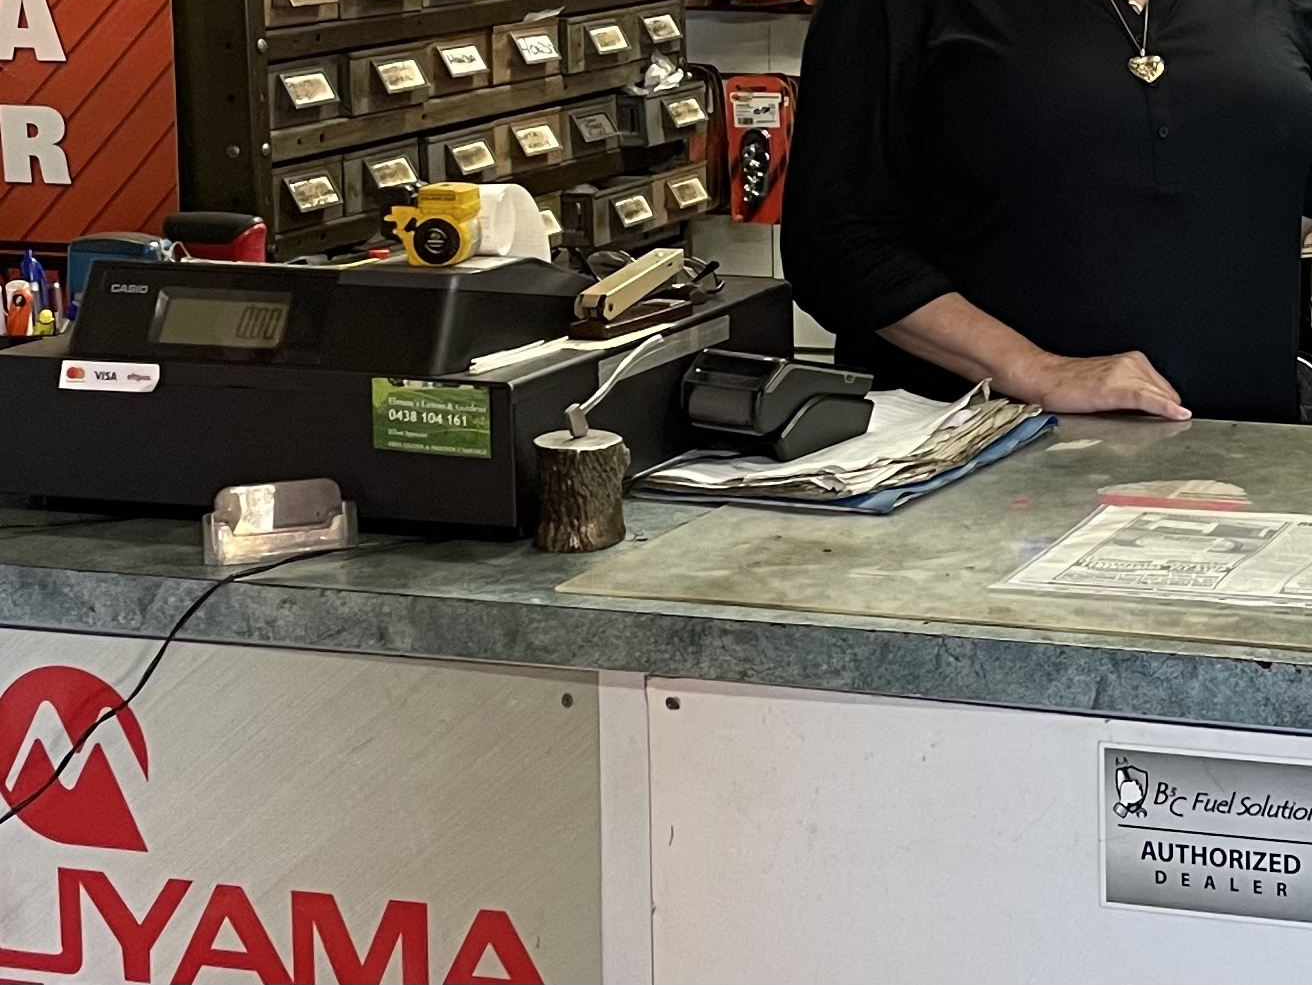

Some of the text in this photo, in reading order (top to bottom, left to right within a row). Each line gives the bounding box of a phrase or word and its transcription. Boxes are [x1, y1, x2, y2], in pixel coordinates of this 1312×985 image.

[111, 284, 149, 294] CASIO
[94, 371, 117, 381] VISA
[388, 408, 468, 427] 0438 104 161
[1192, 791, 1237, 814] Fuel
[1141, 840, 1302, 875] AUTHORIZED
[1155, 870, 1288, 897] DEALER
